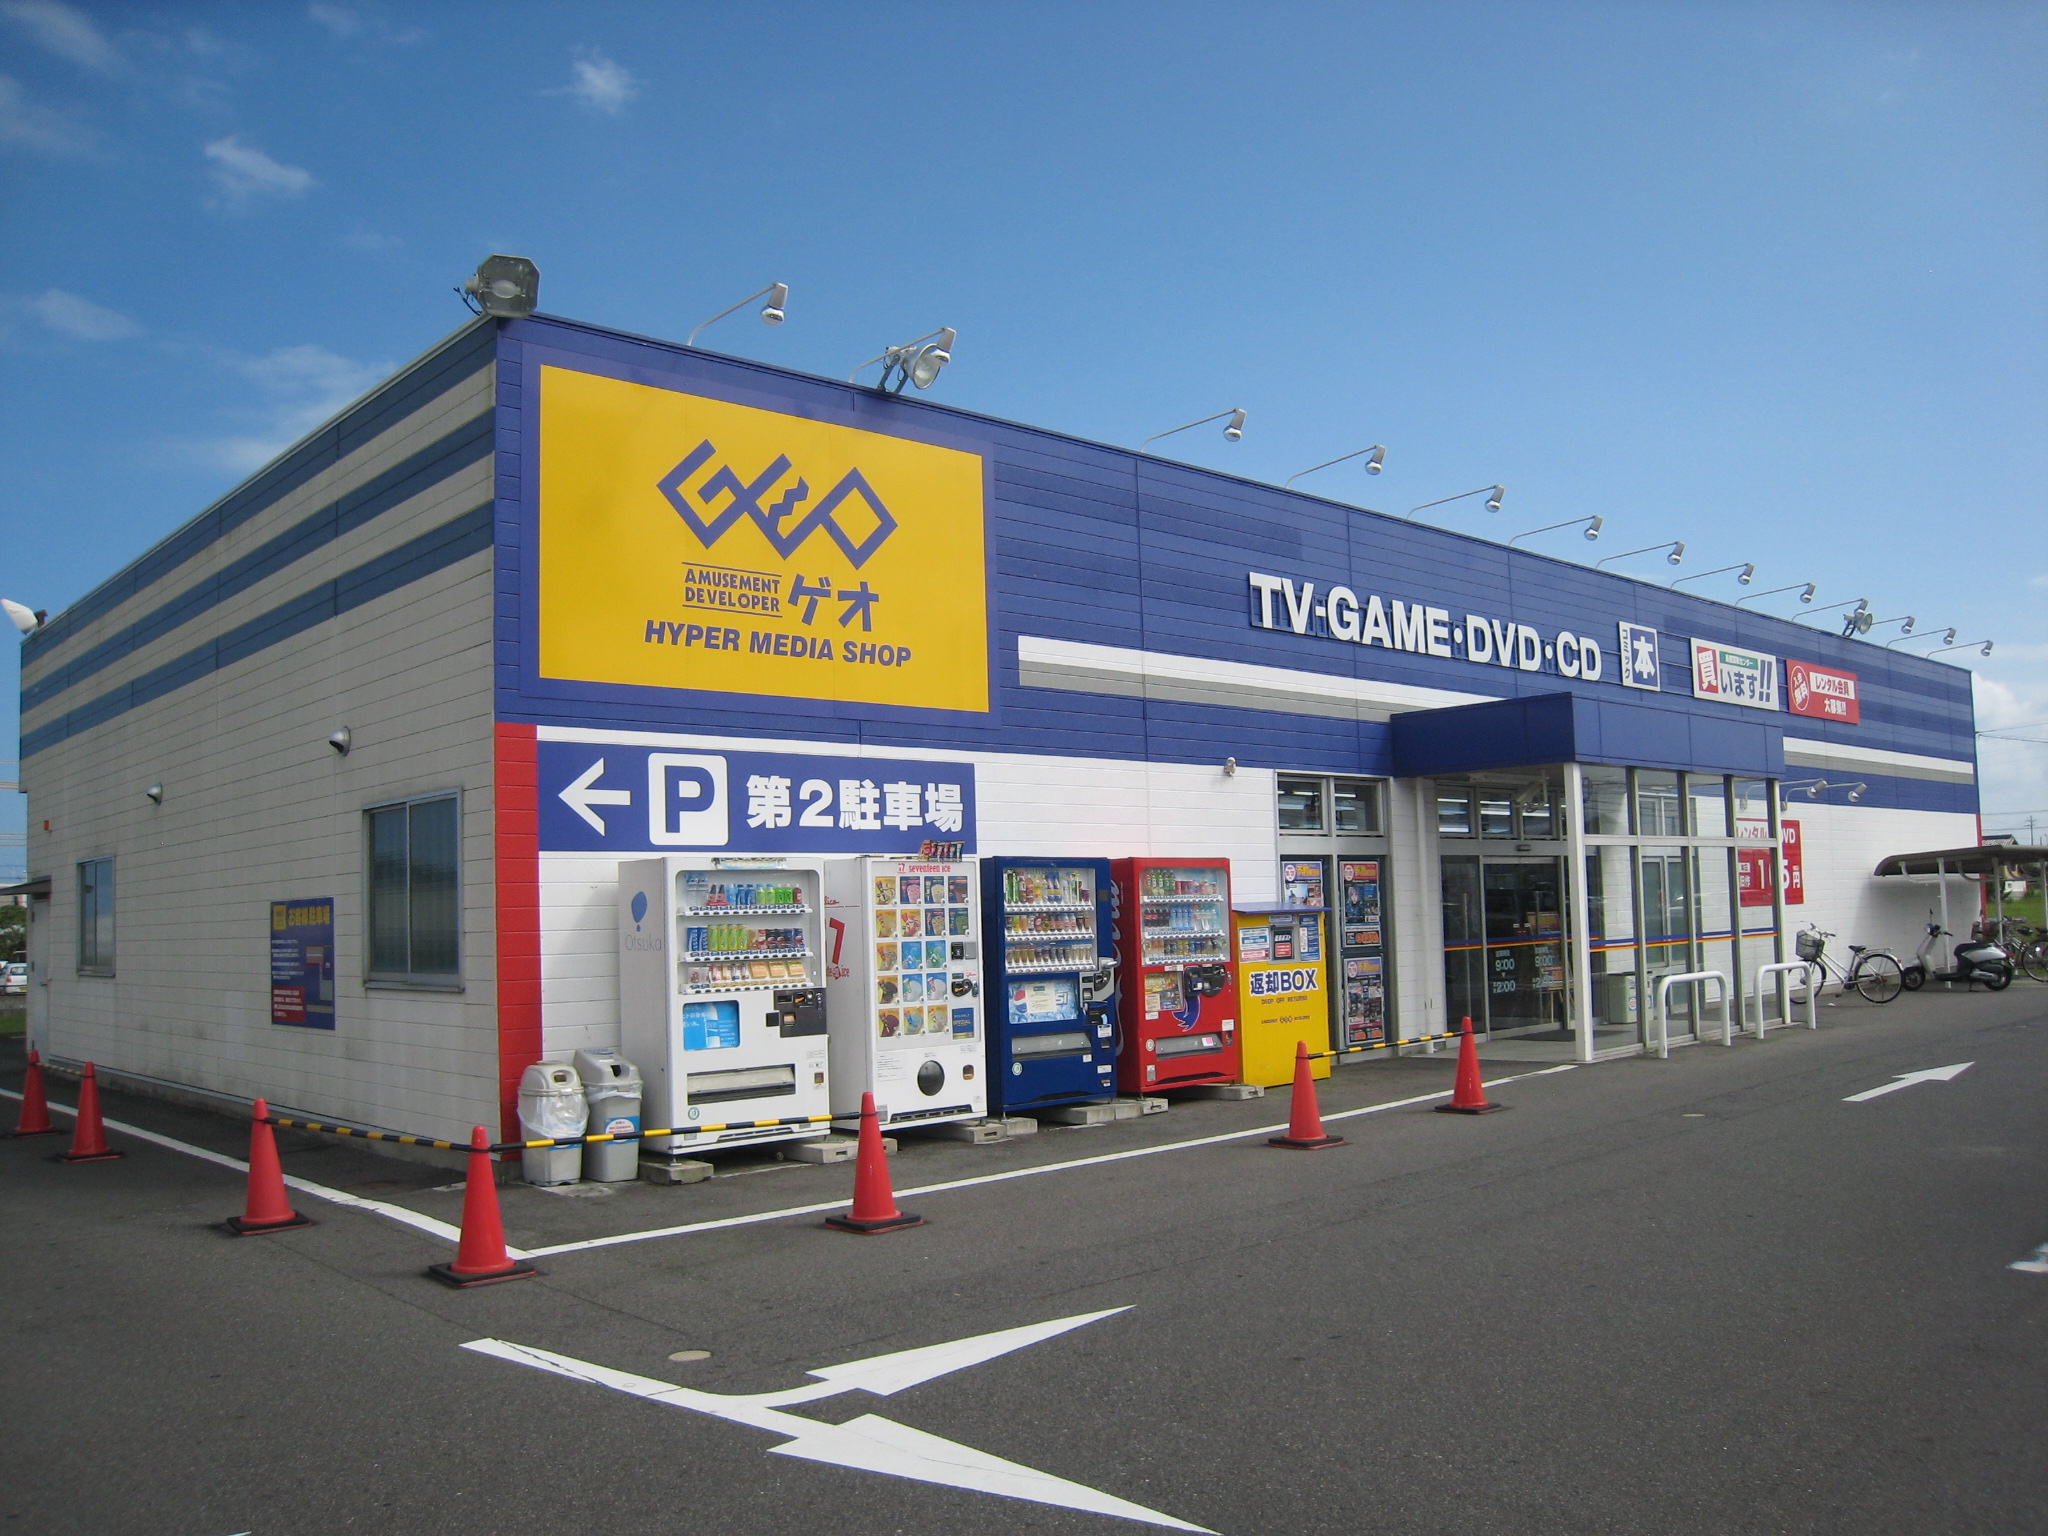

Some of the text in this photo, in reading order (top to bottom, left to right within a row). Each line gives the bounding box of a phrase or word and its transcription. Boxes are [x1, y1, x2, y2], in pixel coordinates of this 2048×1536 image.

[684, 568, 781, 595] AMUSEMENT
[684, 587, 781, 612] DEVELOPER
[788, 573, 880, 632] ゲオ
[645, 619, 912, 667] HYPER MEDIA SHOP
[1622, 629, 1630, 679] コミック
[1633, 636, 1655, 679] 本
[1815, 676, 1849, 696] レンタル会員
[664, 764, 716, 834] P
[746, 774, 964, 832] 第2駐車場
[908, 863, 940, 873] seventeen
[941, 864, 952, 873] ice
[626, 934, 661, 950] Otsuka
[1495, 959, 1514, 971] 9:00
[1250, 969, 1318, 995] 返却BOX
